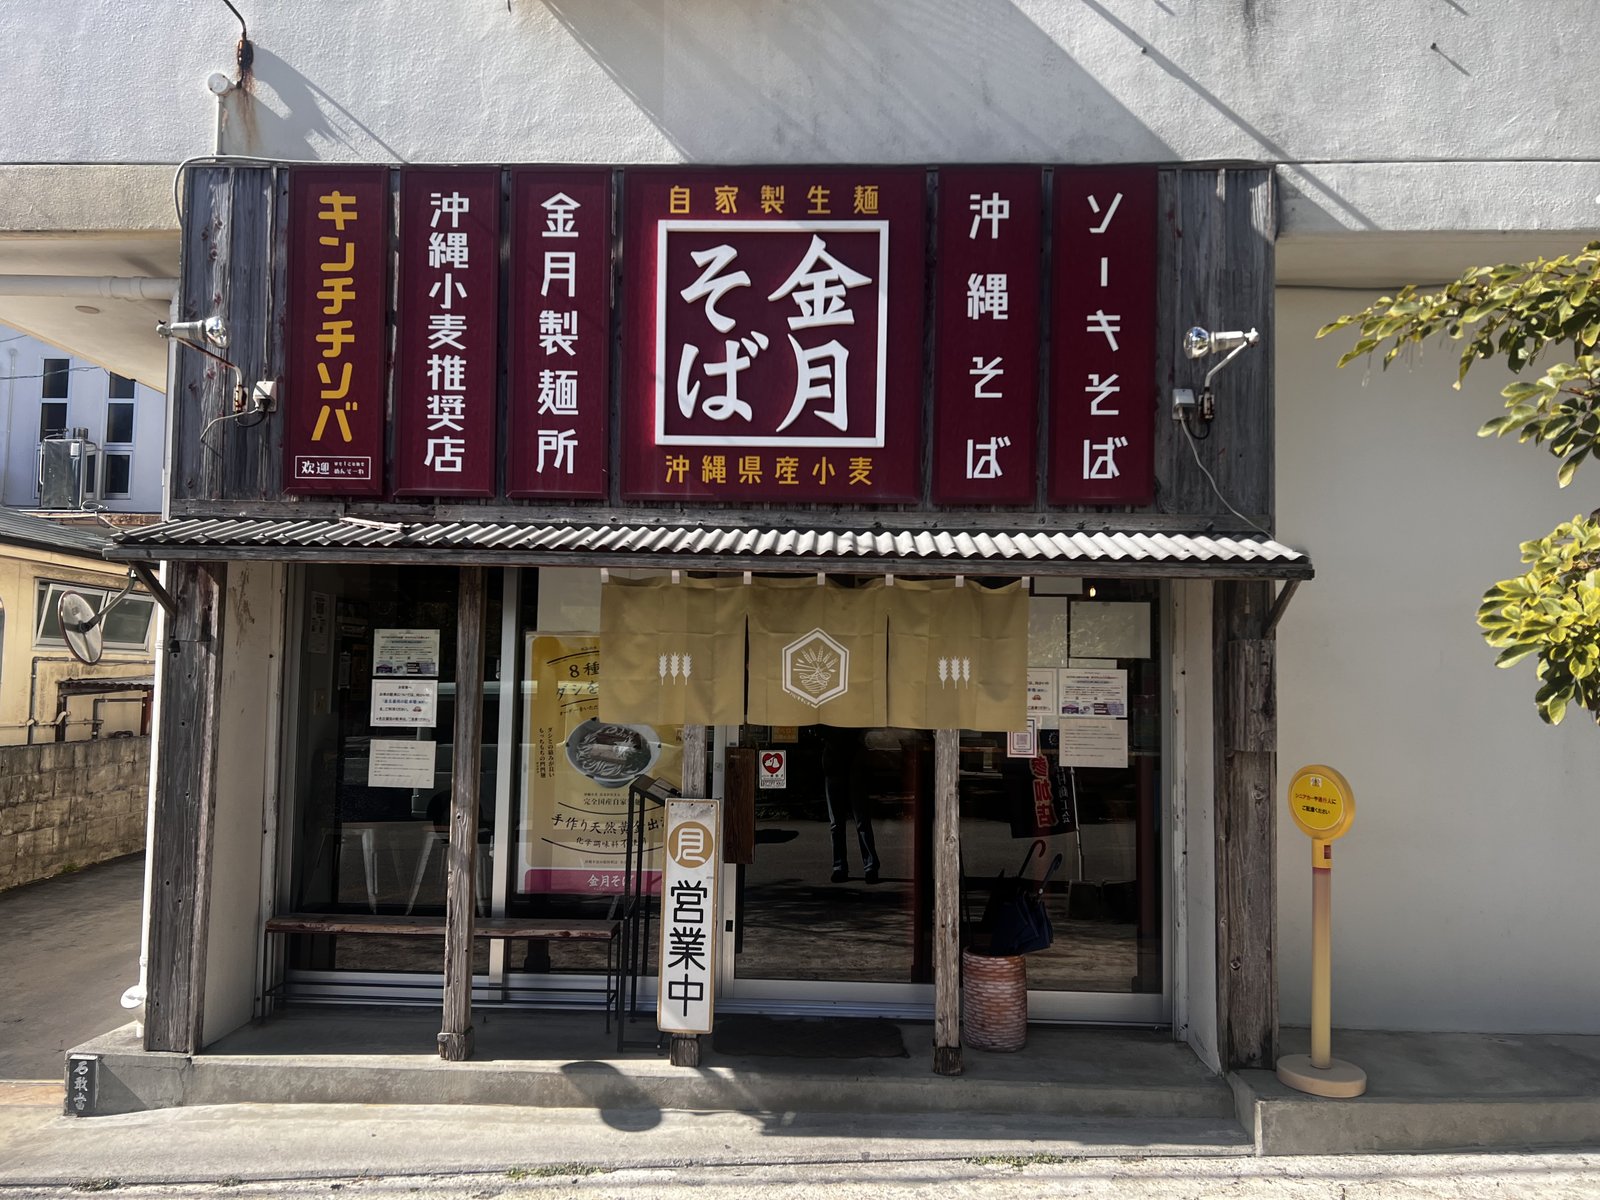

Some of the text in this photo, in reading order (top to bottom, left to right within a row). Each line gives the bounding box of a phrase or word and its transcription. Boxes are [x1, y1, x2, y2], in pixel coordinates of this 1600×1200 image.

[669, 185, 880, 214] 自家製生麺
[311, 190, 358, 442] キンチチソバ
[423, 192, 470, 472] 沖縄小麦推奨店
[537, 192, 581, 474] 金月製麺所
[676, 243, 769, 423] そば
[768, 233, 873, 433] 金月
[966, 192, 1011, 479] 沖縄そば
[1083, 193, 1128, 480] ソーキそば
[665, 454, 873, 486] 沖縄県産小麦
[667, 879, 708, 1017] 営業中
